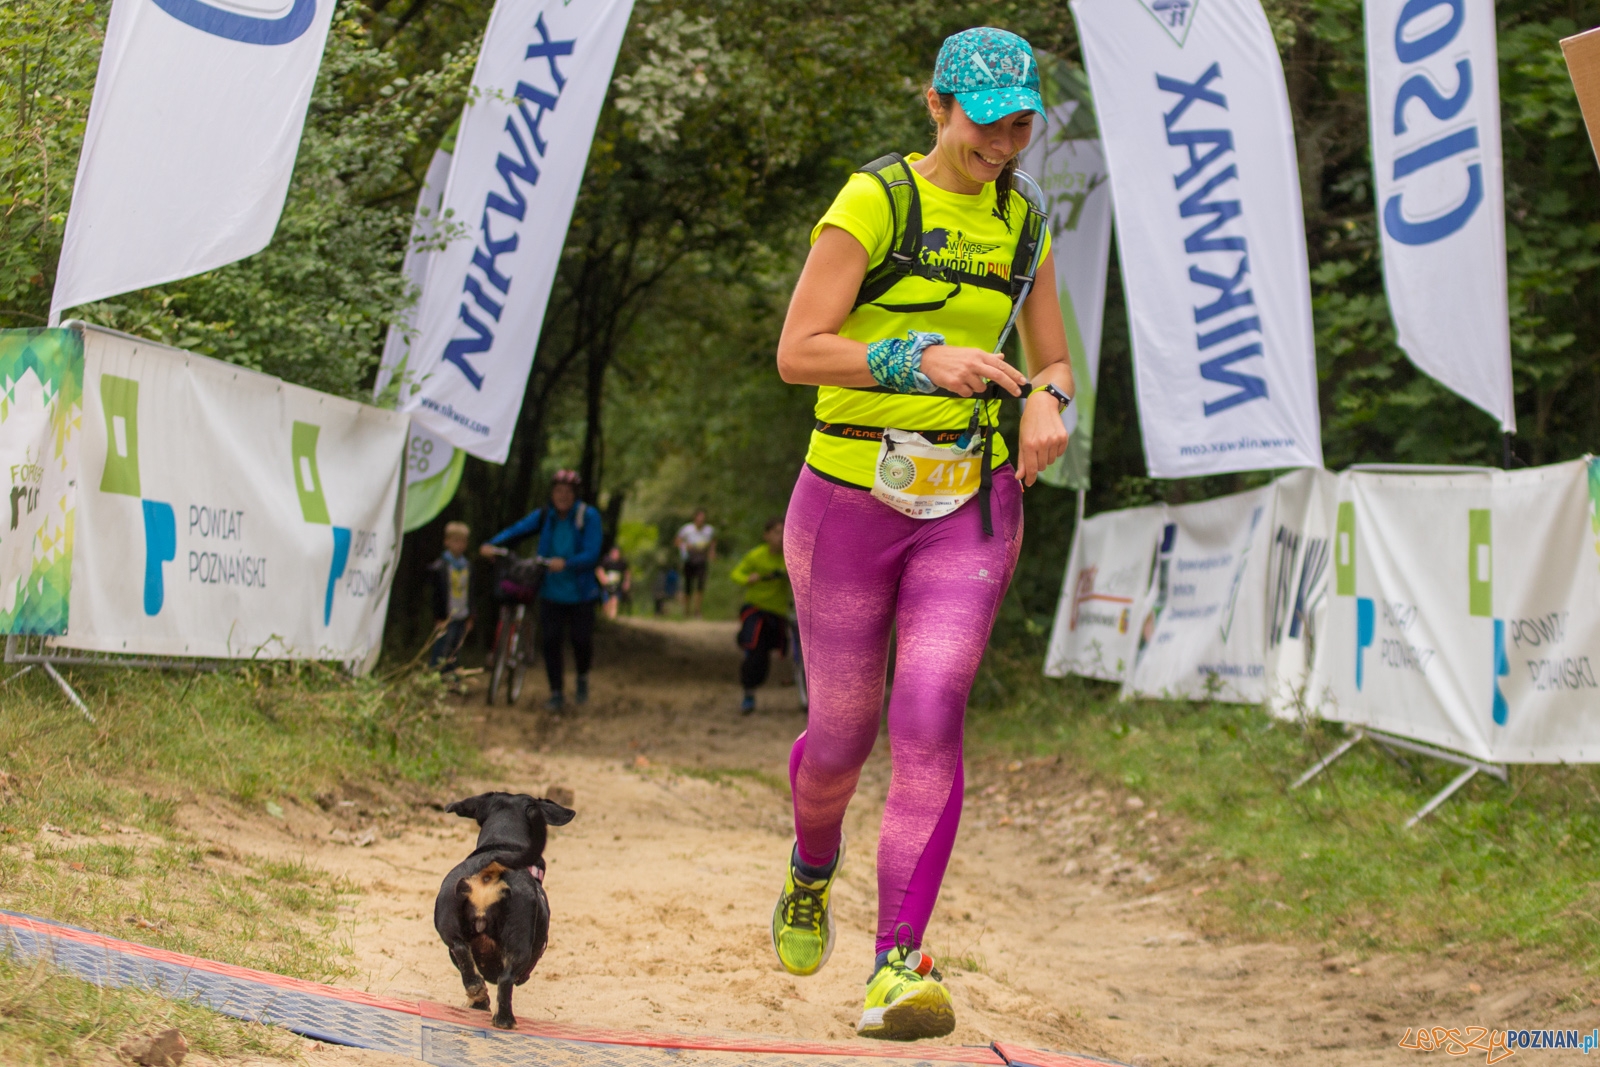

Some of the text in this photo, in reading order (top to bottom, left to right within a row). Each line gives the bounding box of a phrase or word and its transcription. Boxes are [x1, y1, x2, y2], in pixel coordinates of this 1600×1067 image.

[441, 11, 577, 392] NIKWAX
[949, 240, 982, 253] WINGS
[955, 250, 973, 260] LIFE
[926, 461, 972, 487] 417
[189, 504, 244, 541] POWIAT
[188, 548, 267, 588] POZNAŃSKI
